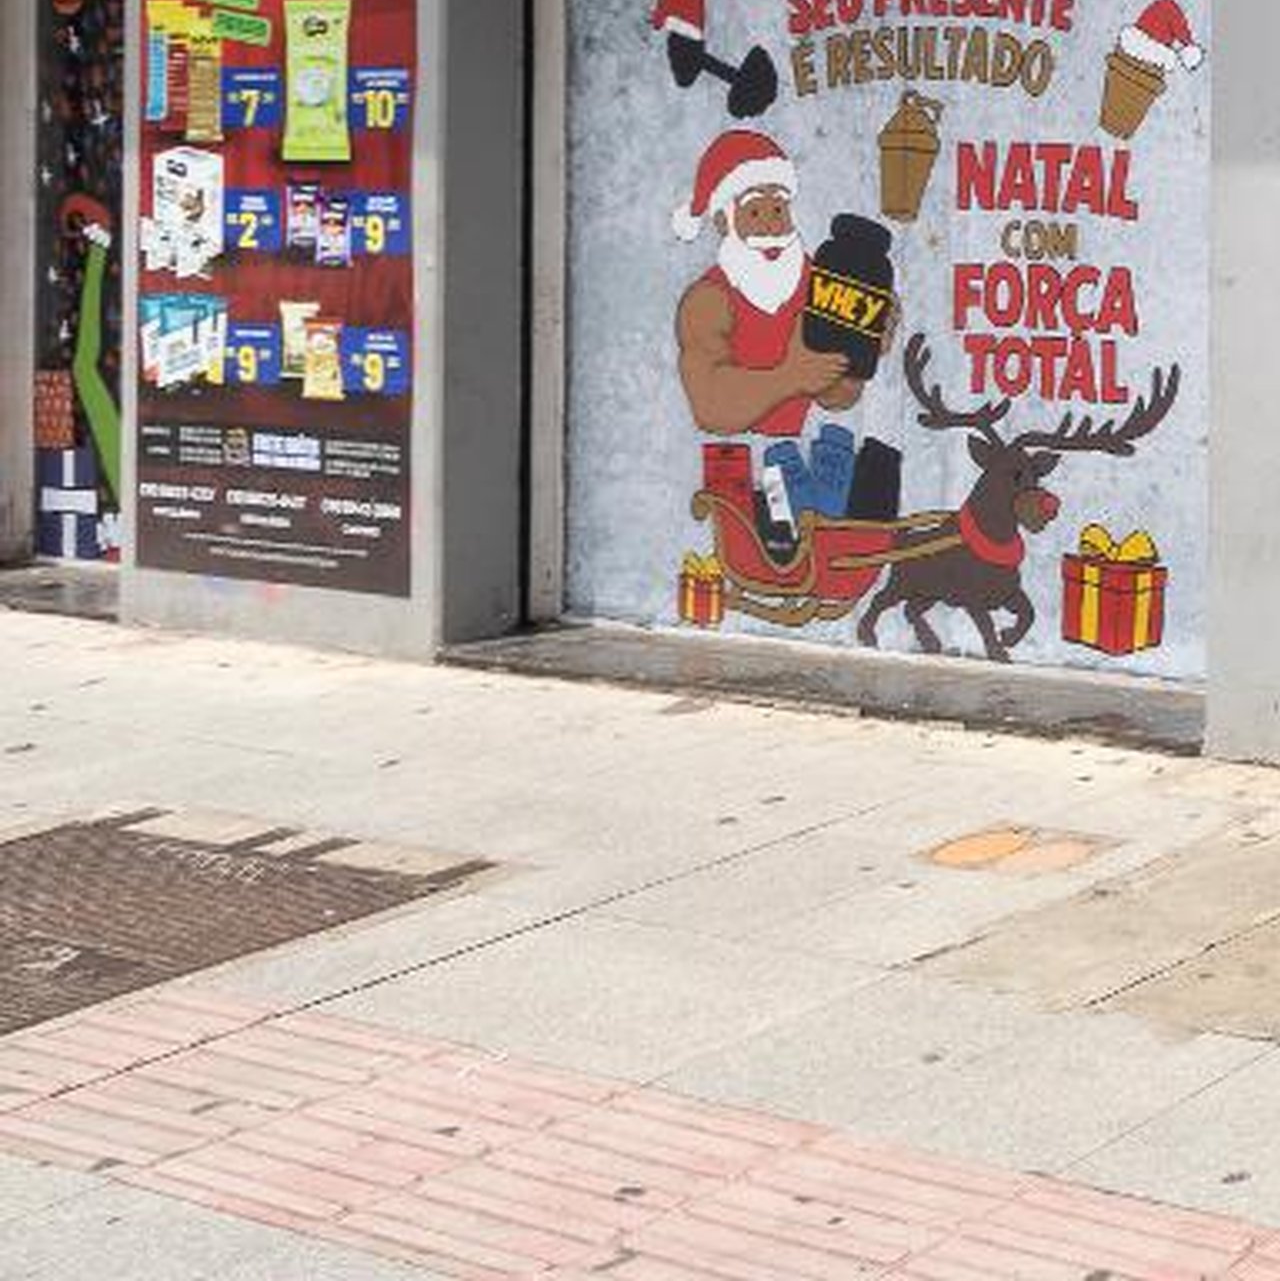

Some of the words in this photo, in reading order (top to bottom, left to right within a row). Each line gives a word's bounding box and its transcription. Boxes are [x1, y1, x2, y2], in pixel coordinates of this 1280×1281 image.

[825, 25, 1056, 97] RESULTADO
[956, 142, 1138, 221] NATAL
[1002, 221, 1076, 261] COM
[812, 276, 886, 329] WHEY
[953, 264, 1138, 341] FORÇA
[964, 337, 1128, 404] TOTAL
